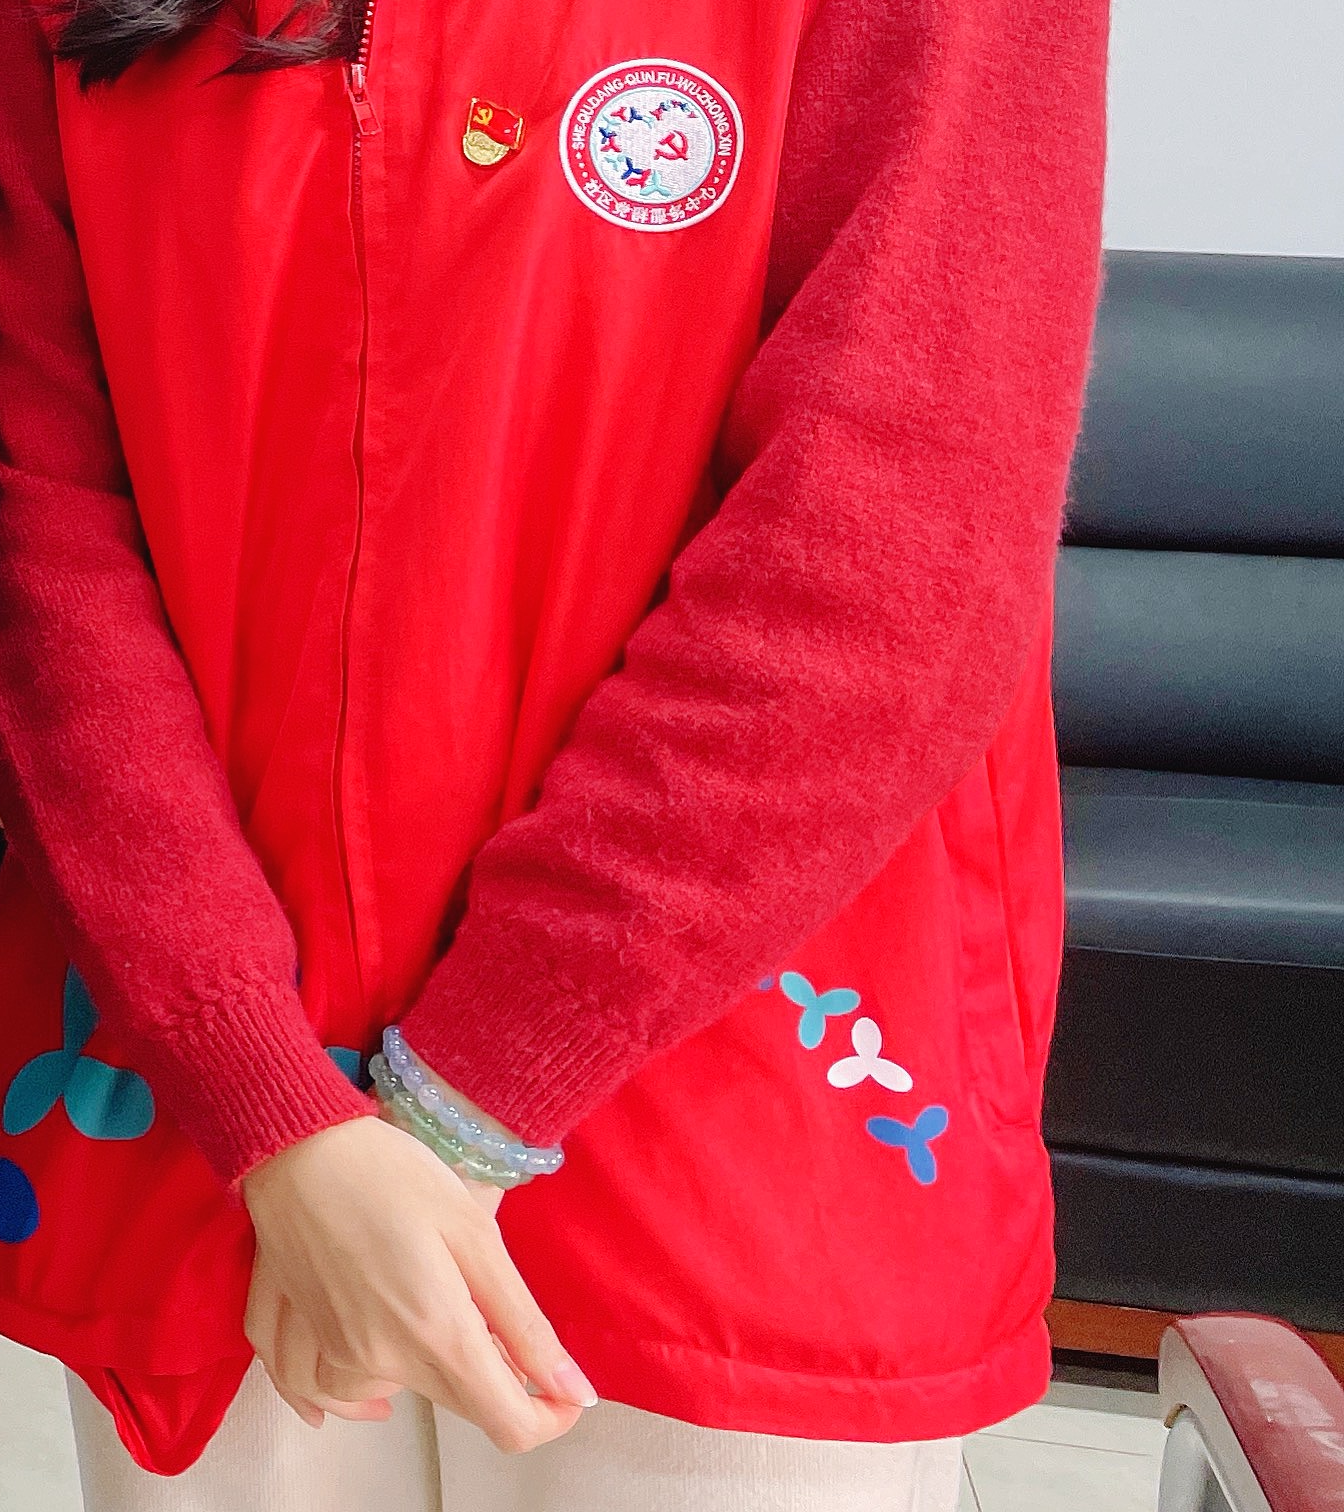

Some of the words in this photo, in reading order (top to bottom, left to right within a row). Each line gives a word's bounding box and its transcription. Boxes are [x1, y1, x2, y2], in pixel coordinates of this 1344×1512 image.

[583, 178, 717, 225] 社区党群服务中心
